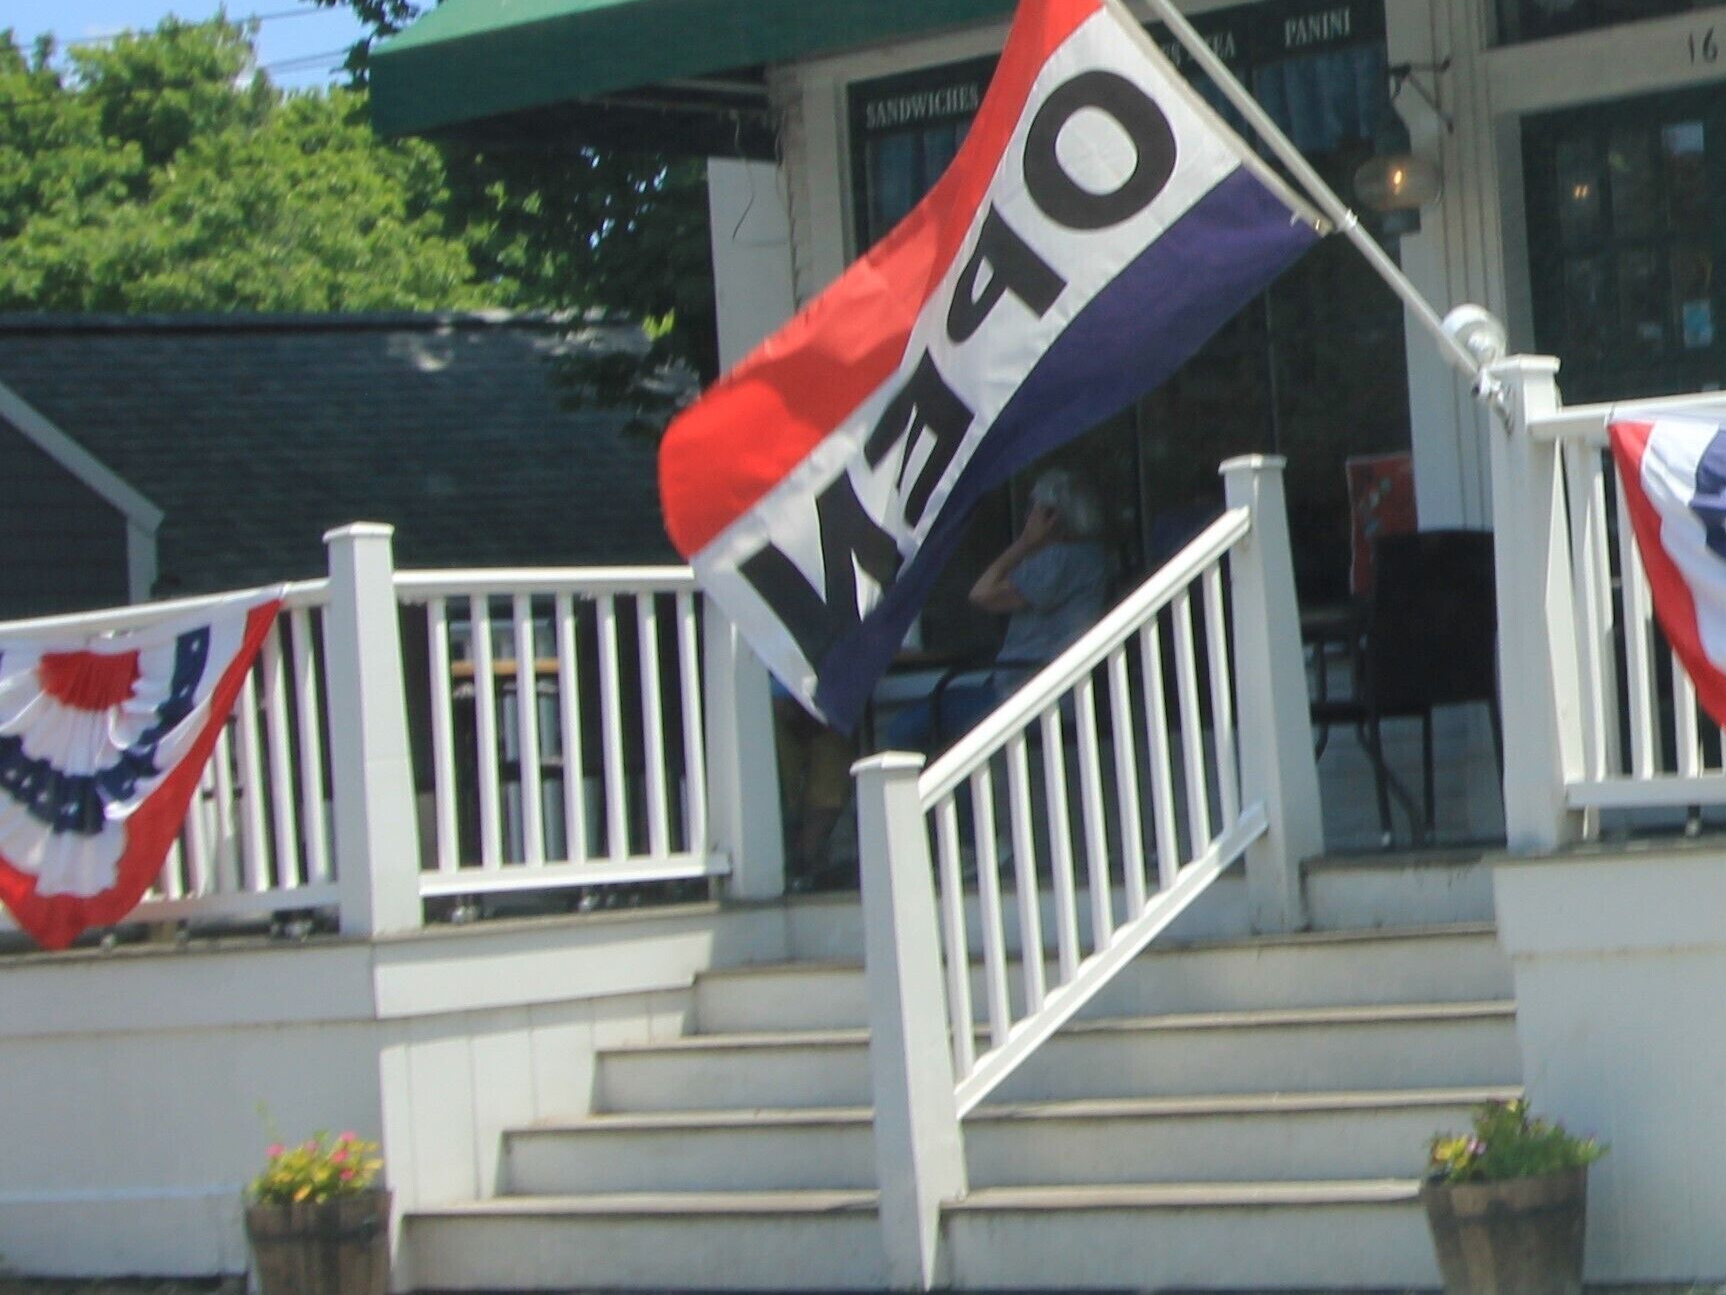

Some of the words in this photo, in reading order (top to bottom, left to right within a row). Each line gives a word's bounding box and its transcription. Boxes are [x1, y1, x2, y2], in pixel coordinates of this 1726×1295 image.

[1284, 7, 1352, 49] PANINI
[1687, 25, 1719, 66] 16
[866, 83, 979, 130] SANDWICHES
